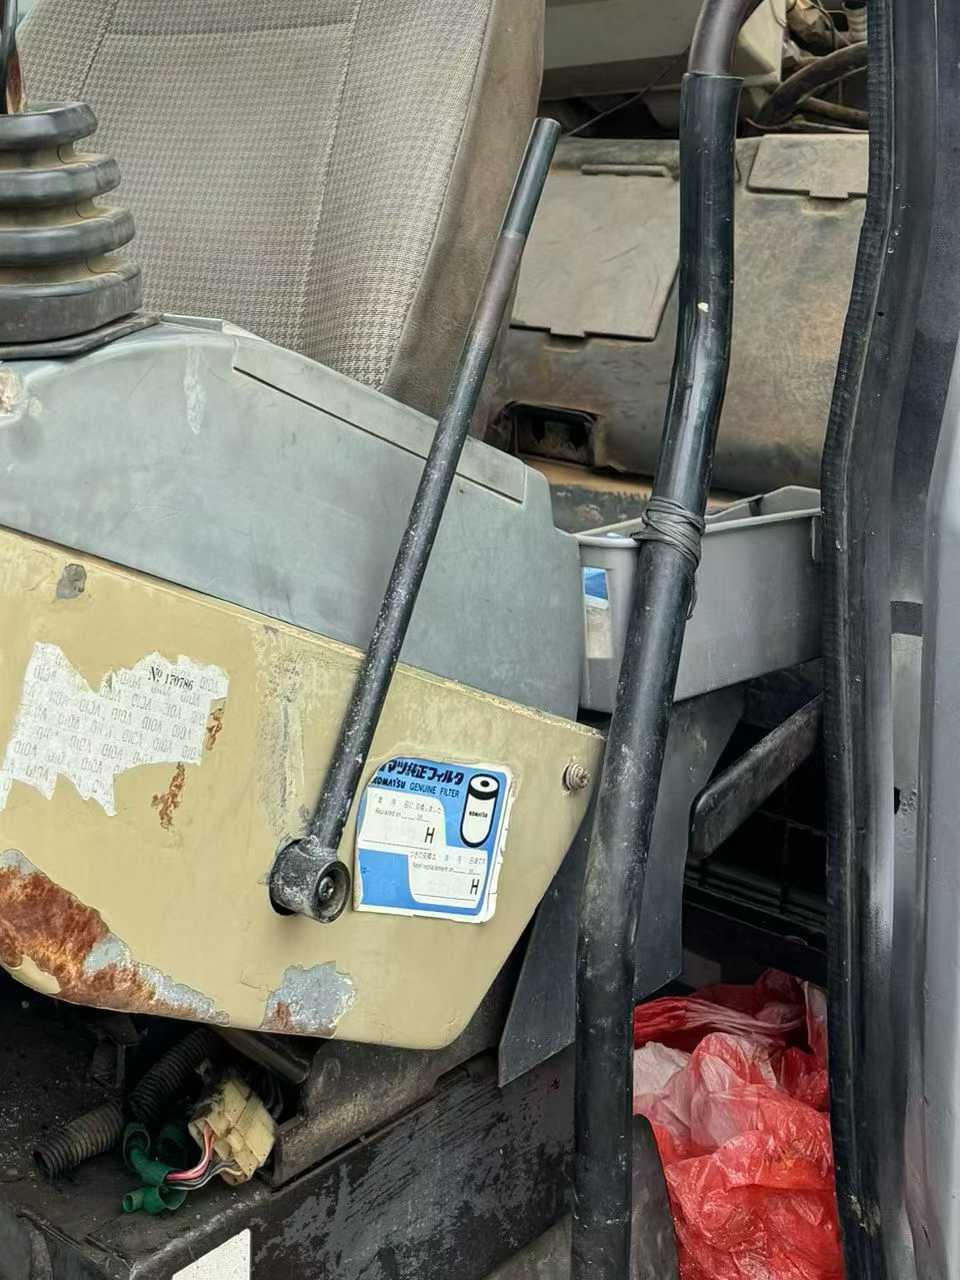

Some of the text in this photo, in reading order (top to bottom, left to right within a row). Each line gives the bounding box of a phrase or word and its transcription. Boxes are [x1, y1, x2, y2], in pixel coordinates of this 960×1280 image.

[165, 673, 194, 690] 170786
[409, 781, 437, 795] GENUINE
[439, 787, 460, 799] FILTER
[424, 826, 435, 844] H
[469, 878, 480, 896] H
